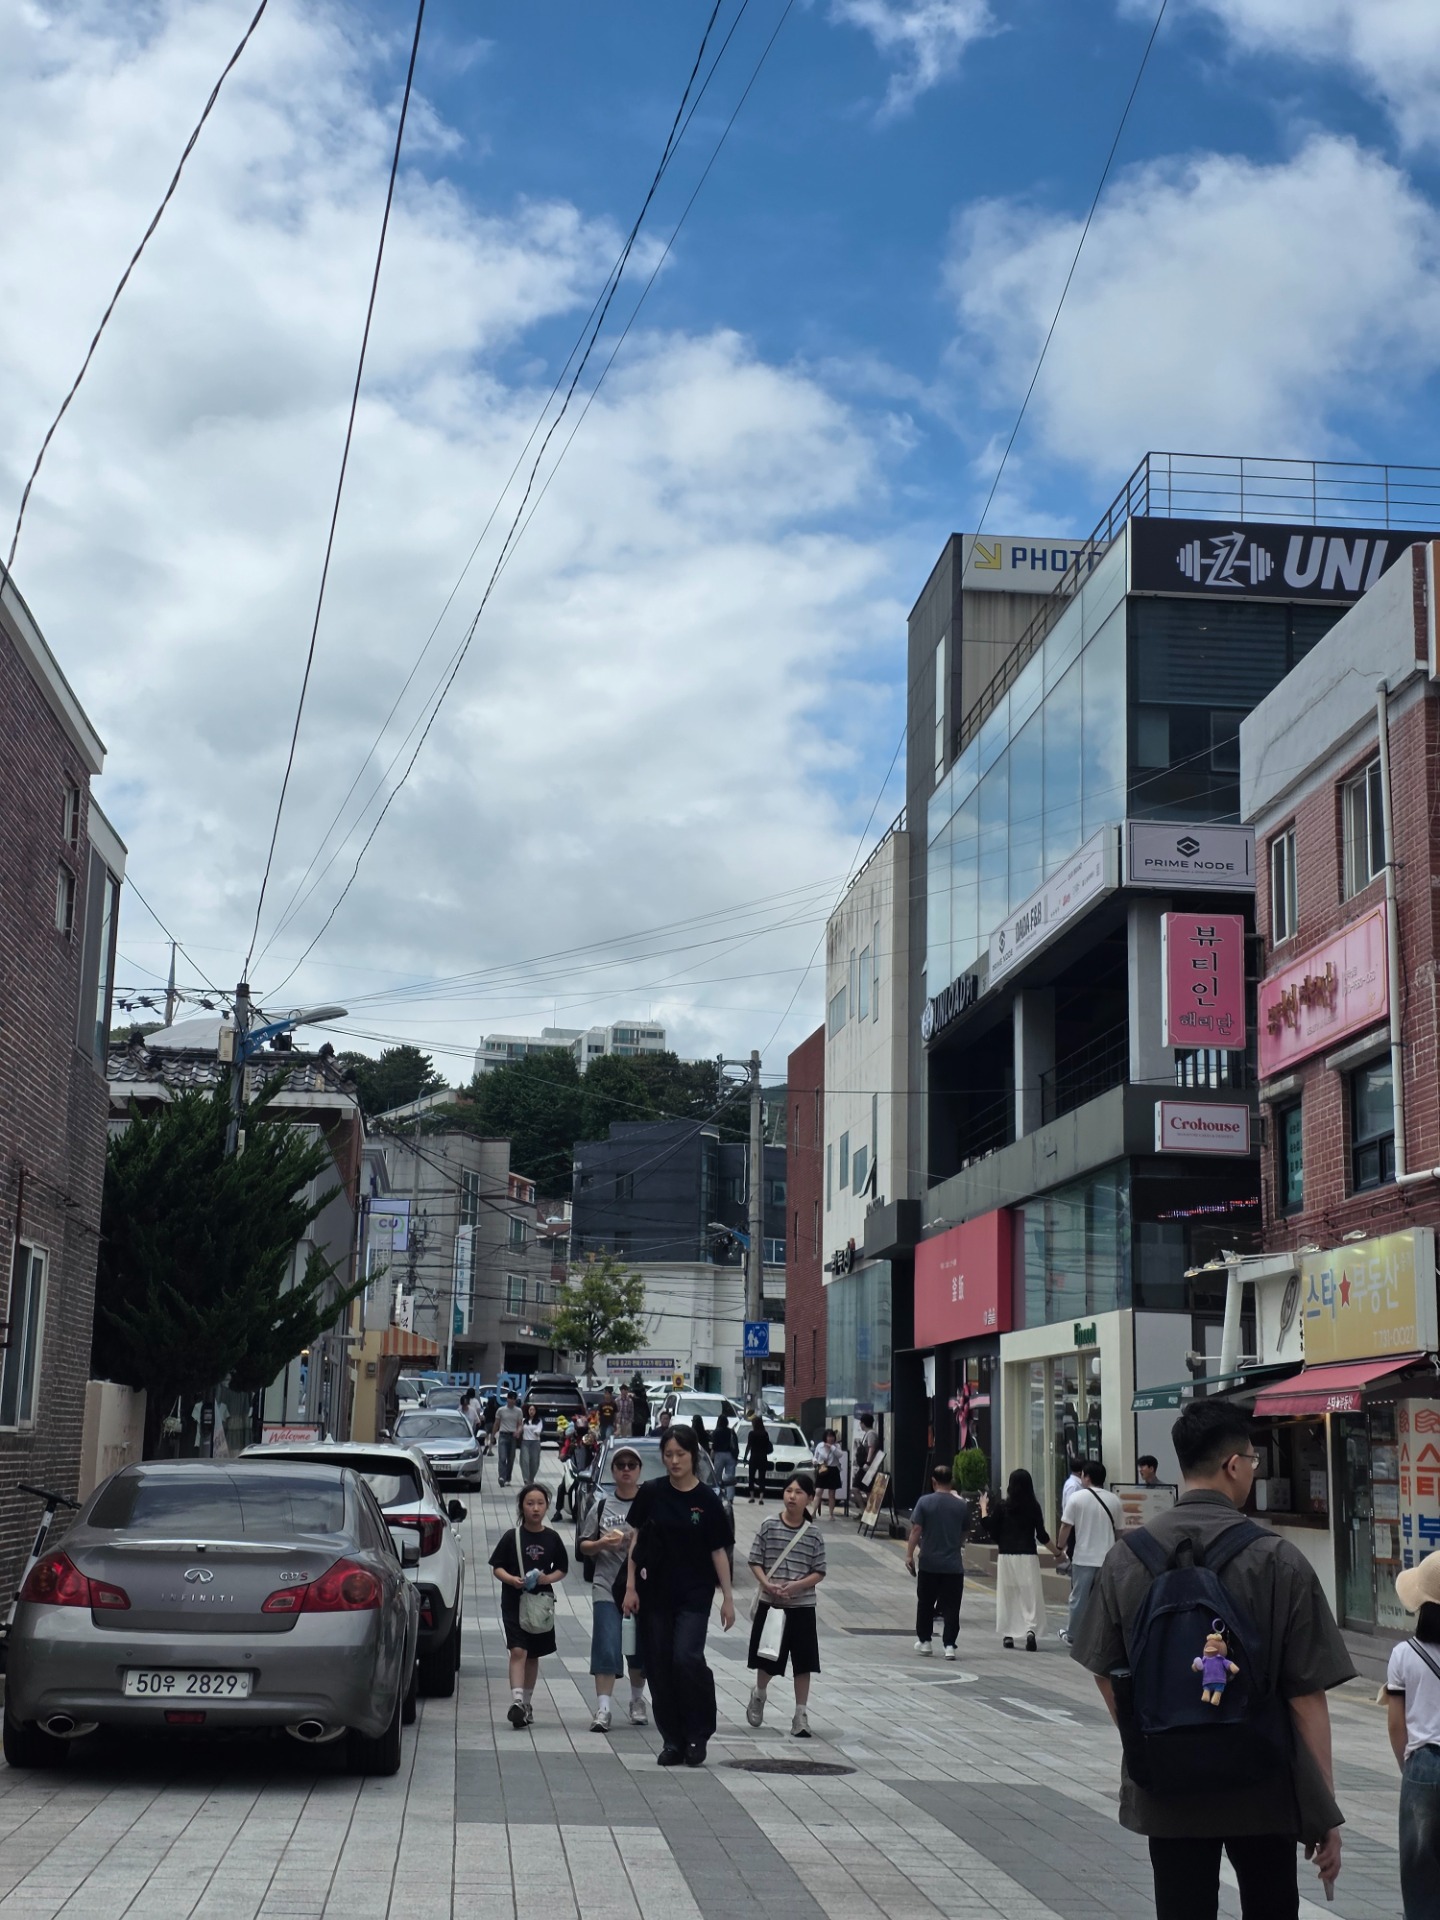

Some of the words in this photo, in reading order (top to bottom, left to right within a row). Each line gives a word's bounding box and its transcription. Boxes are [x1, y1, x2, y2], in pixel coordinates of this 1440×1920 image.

[1145, 858, 1189, 868] PRIME
[1194, 861, 1235, 871] NODE
[1189, 926, 1223, 1006] 뷰티인
[1180, 1012, 1233, 1036] 해리단
[1170, 1116, 1240, 1133] Crohouse
[379, 1218, 399, 1229] CU
[1306, 1268, 1337, 1319] 스타
[1352, 1252, 1400, 1314] 부동산
[269, 1430, 311, 1443] Welcome
[161, 1592, 234, 1602] INFINITI
[136, 1673, 176, 1694] 50우
[186, 1674, 238, 1695] 2829
